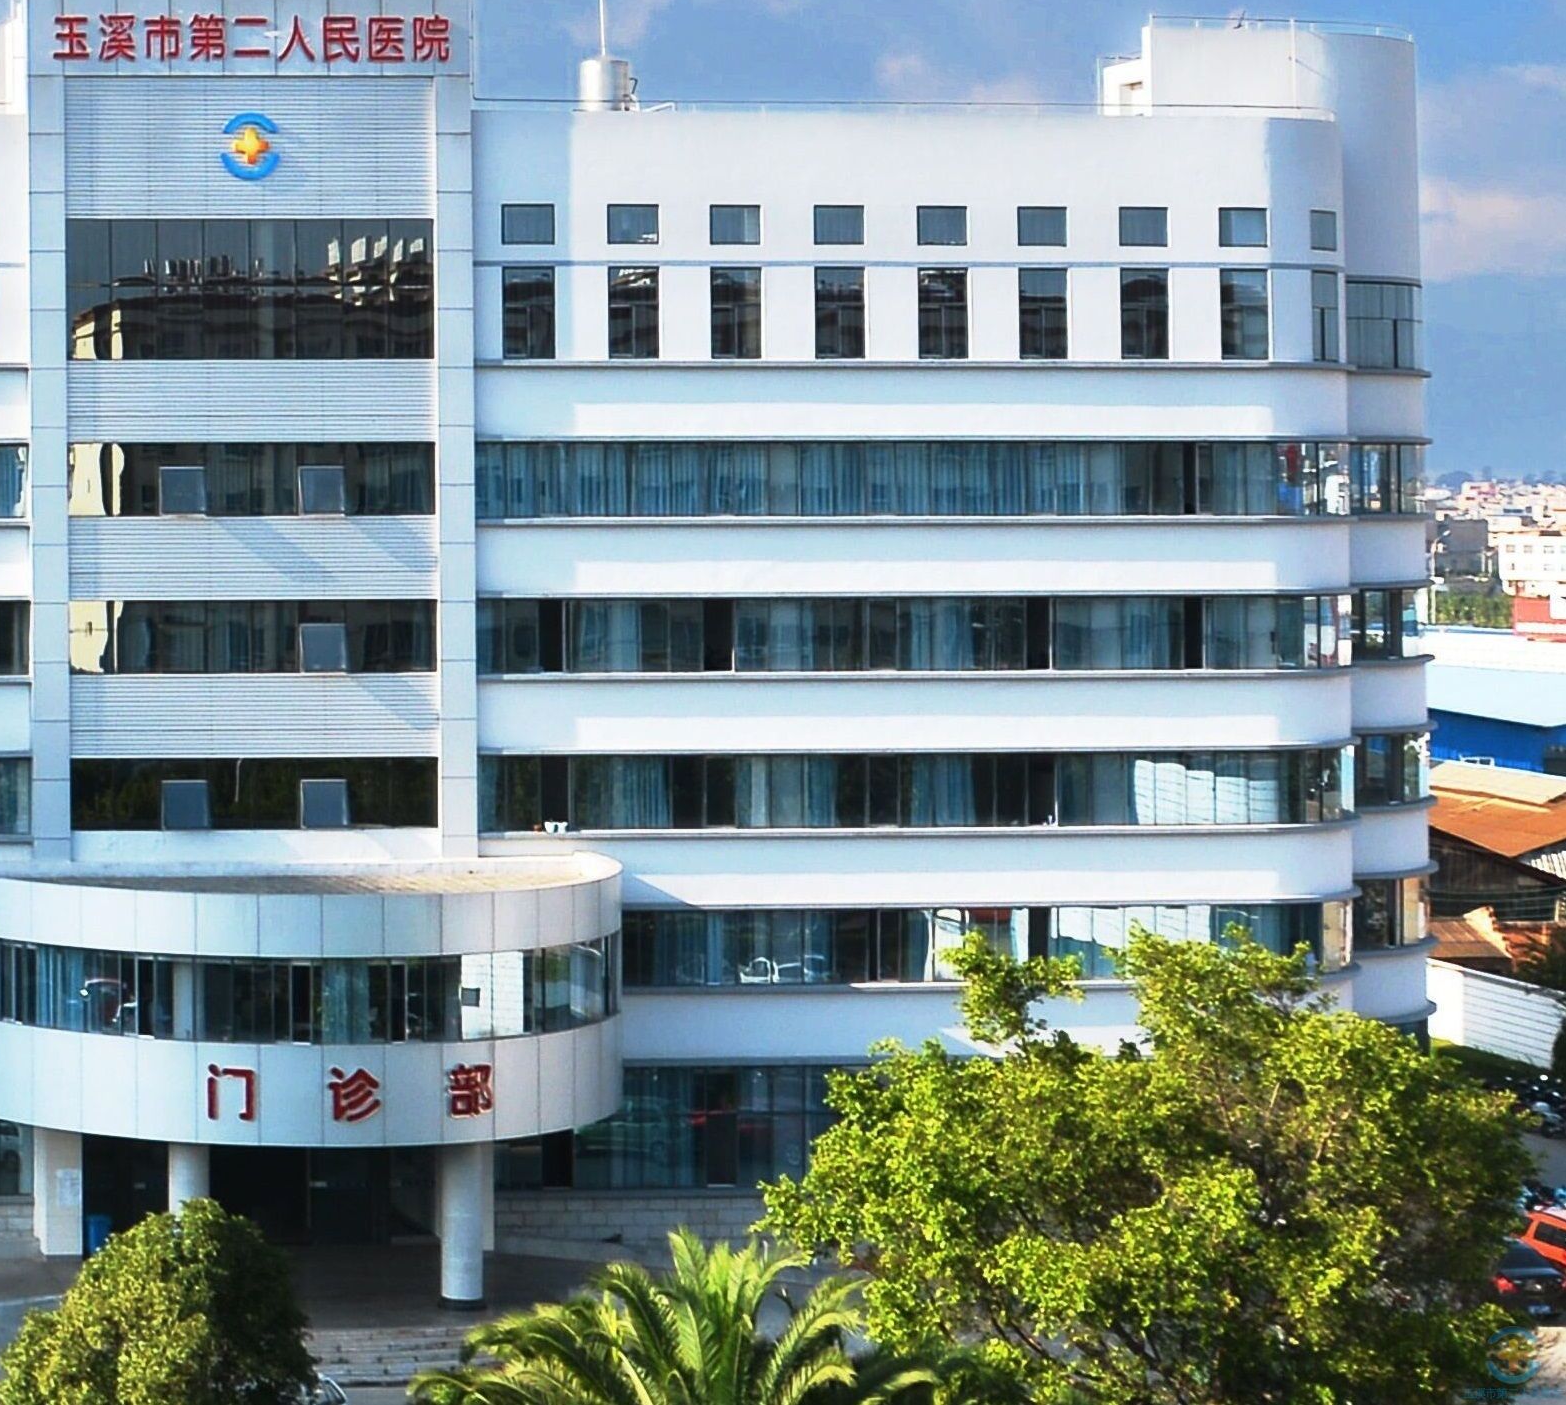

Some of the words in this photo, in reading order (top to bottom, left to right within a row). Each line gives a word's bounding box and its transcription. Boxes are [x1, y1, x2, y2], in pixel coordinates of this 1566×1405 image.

[53, 13, 450, 63] 玉溪市第二人民医院
[206, 1063, 494, 1122] 门诊部
